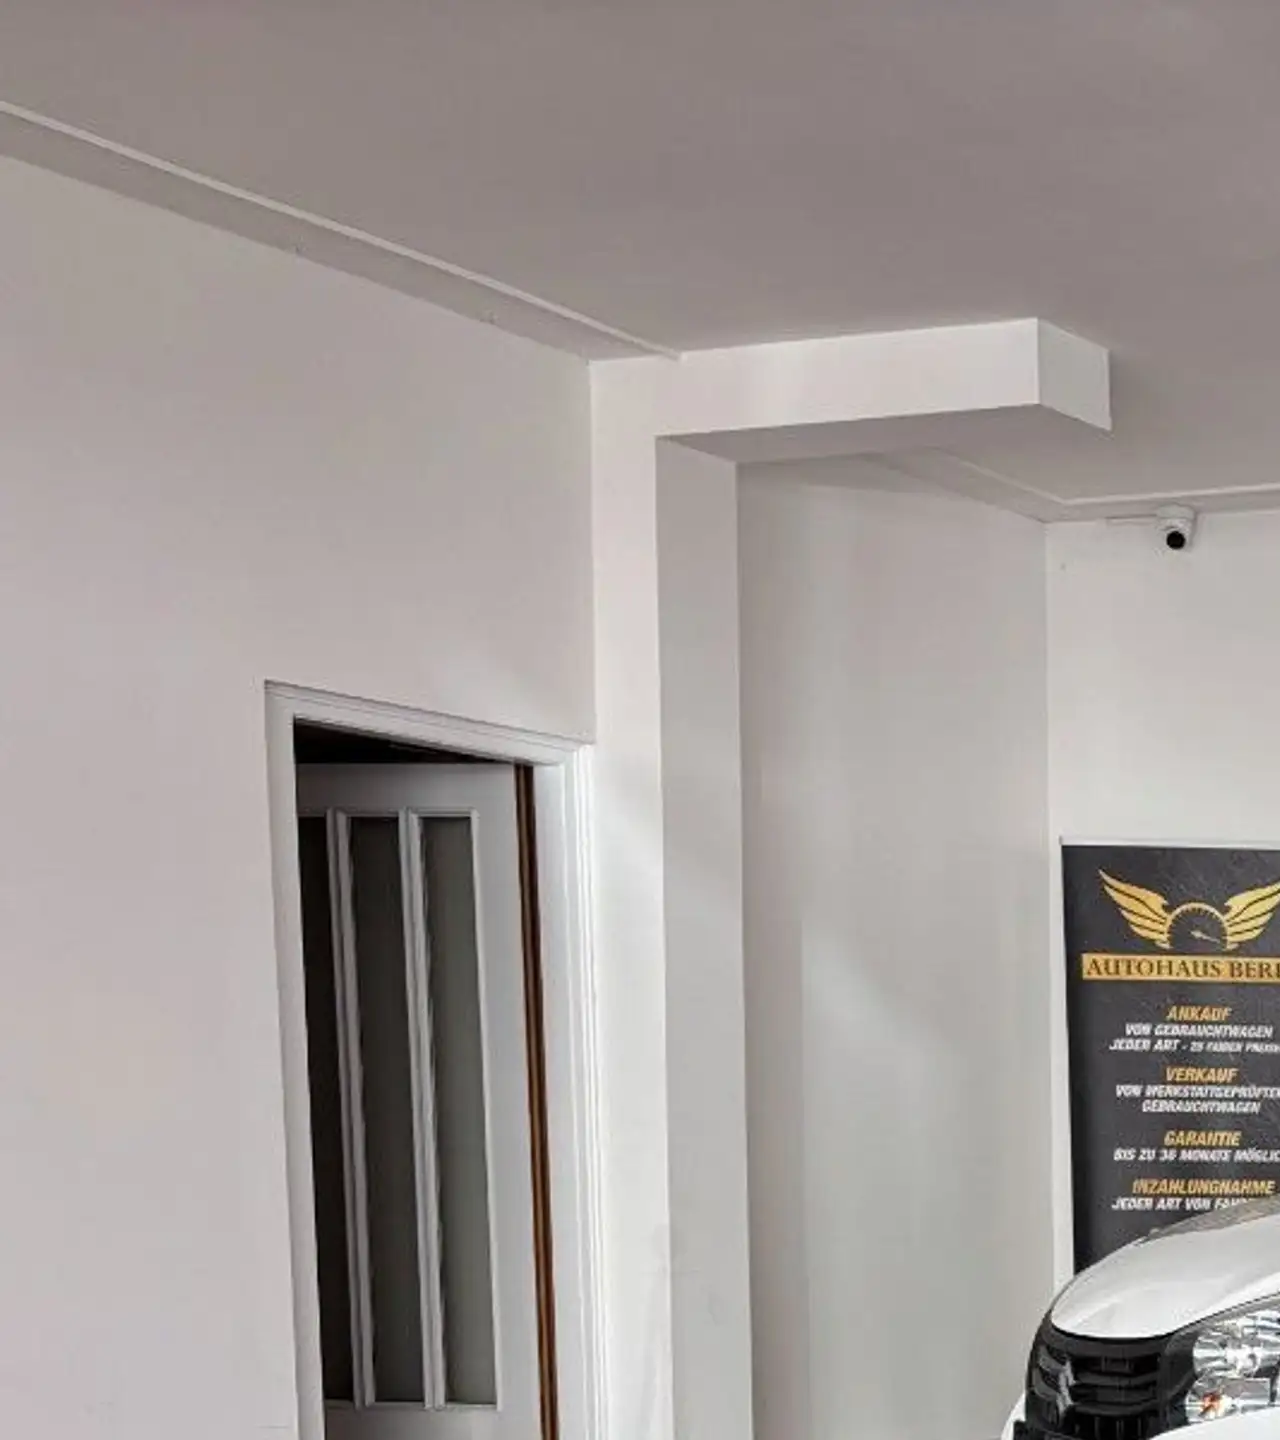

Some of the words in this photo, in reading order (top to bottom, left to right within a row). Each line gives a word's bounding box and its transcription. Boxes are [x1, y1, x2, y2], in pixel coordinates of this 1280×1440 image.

[1086, 957, 1222, 978] AUTOHAUS
[1166, 1005, 1232, 1021] ANKAUF
[1125, 1023, 1151, 1037] VON
[1154, 1024, 1273, 1039] GEBRAUCHTWAGEN
[1109, 1039, 1151, 1051] JEDER
[1153, 1040, 1180, 1052] ART
[1165, 1067, 1239, 1082] VERKAUF
[1142, 1100, 1261, 1114] GEBRAUCHTWAGEN
[1164, 1130, 1242, 1146] GARANTIE
[1132, 1178, 1276, 1195] INZAHLUNGNAHME
[1111, 1198, 1152, 1211] JEDER
[1156, 1198, 1182, 1210] ART
